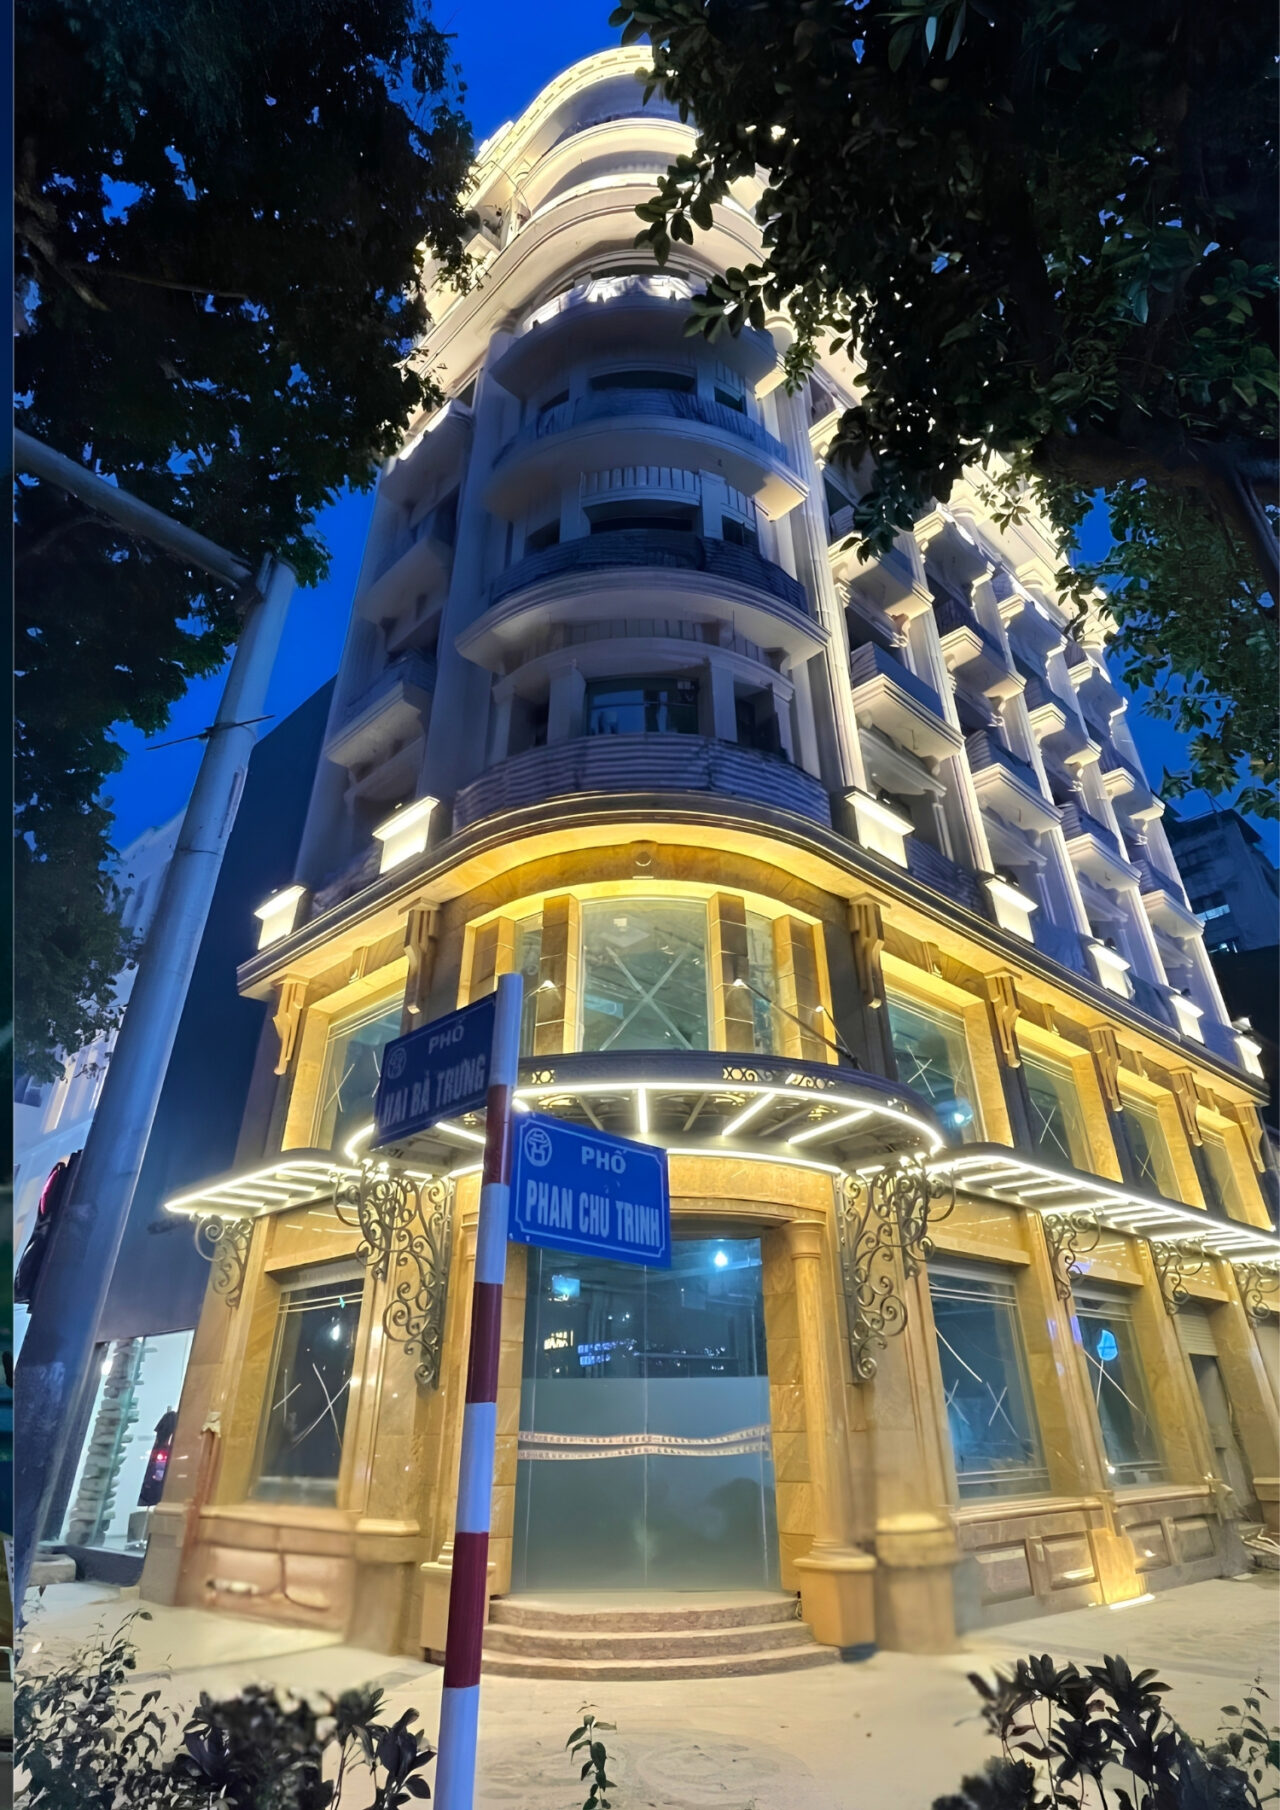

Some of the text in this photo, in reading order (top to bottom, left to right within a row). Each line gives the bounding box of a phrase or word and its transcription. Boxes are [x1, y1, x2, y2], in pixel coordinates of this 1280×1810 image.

[381, 1088, 408, 1128] HAI
[581, 1146, 627, 1174] PHỐ
[525, 1179, 573, 1230] PHAN
[615, 1200, 661, 1247] TRINH
